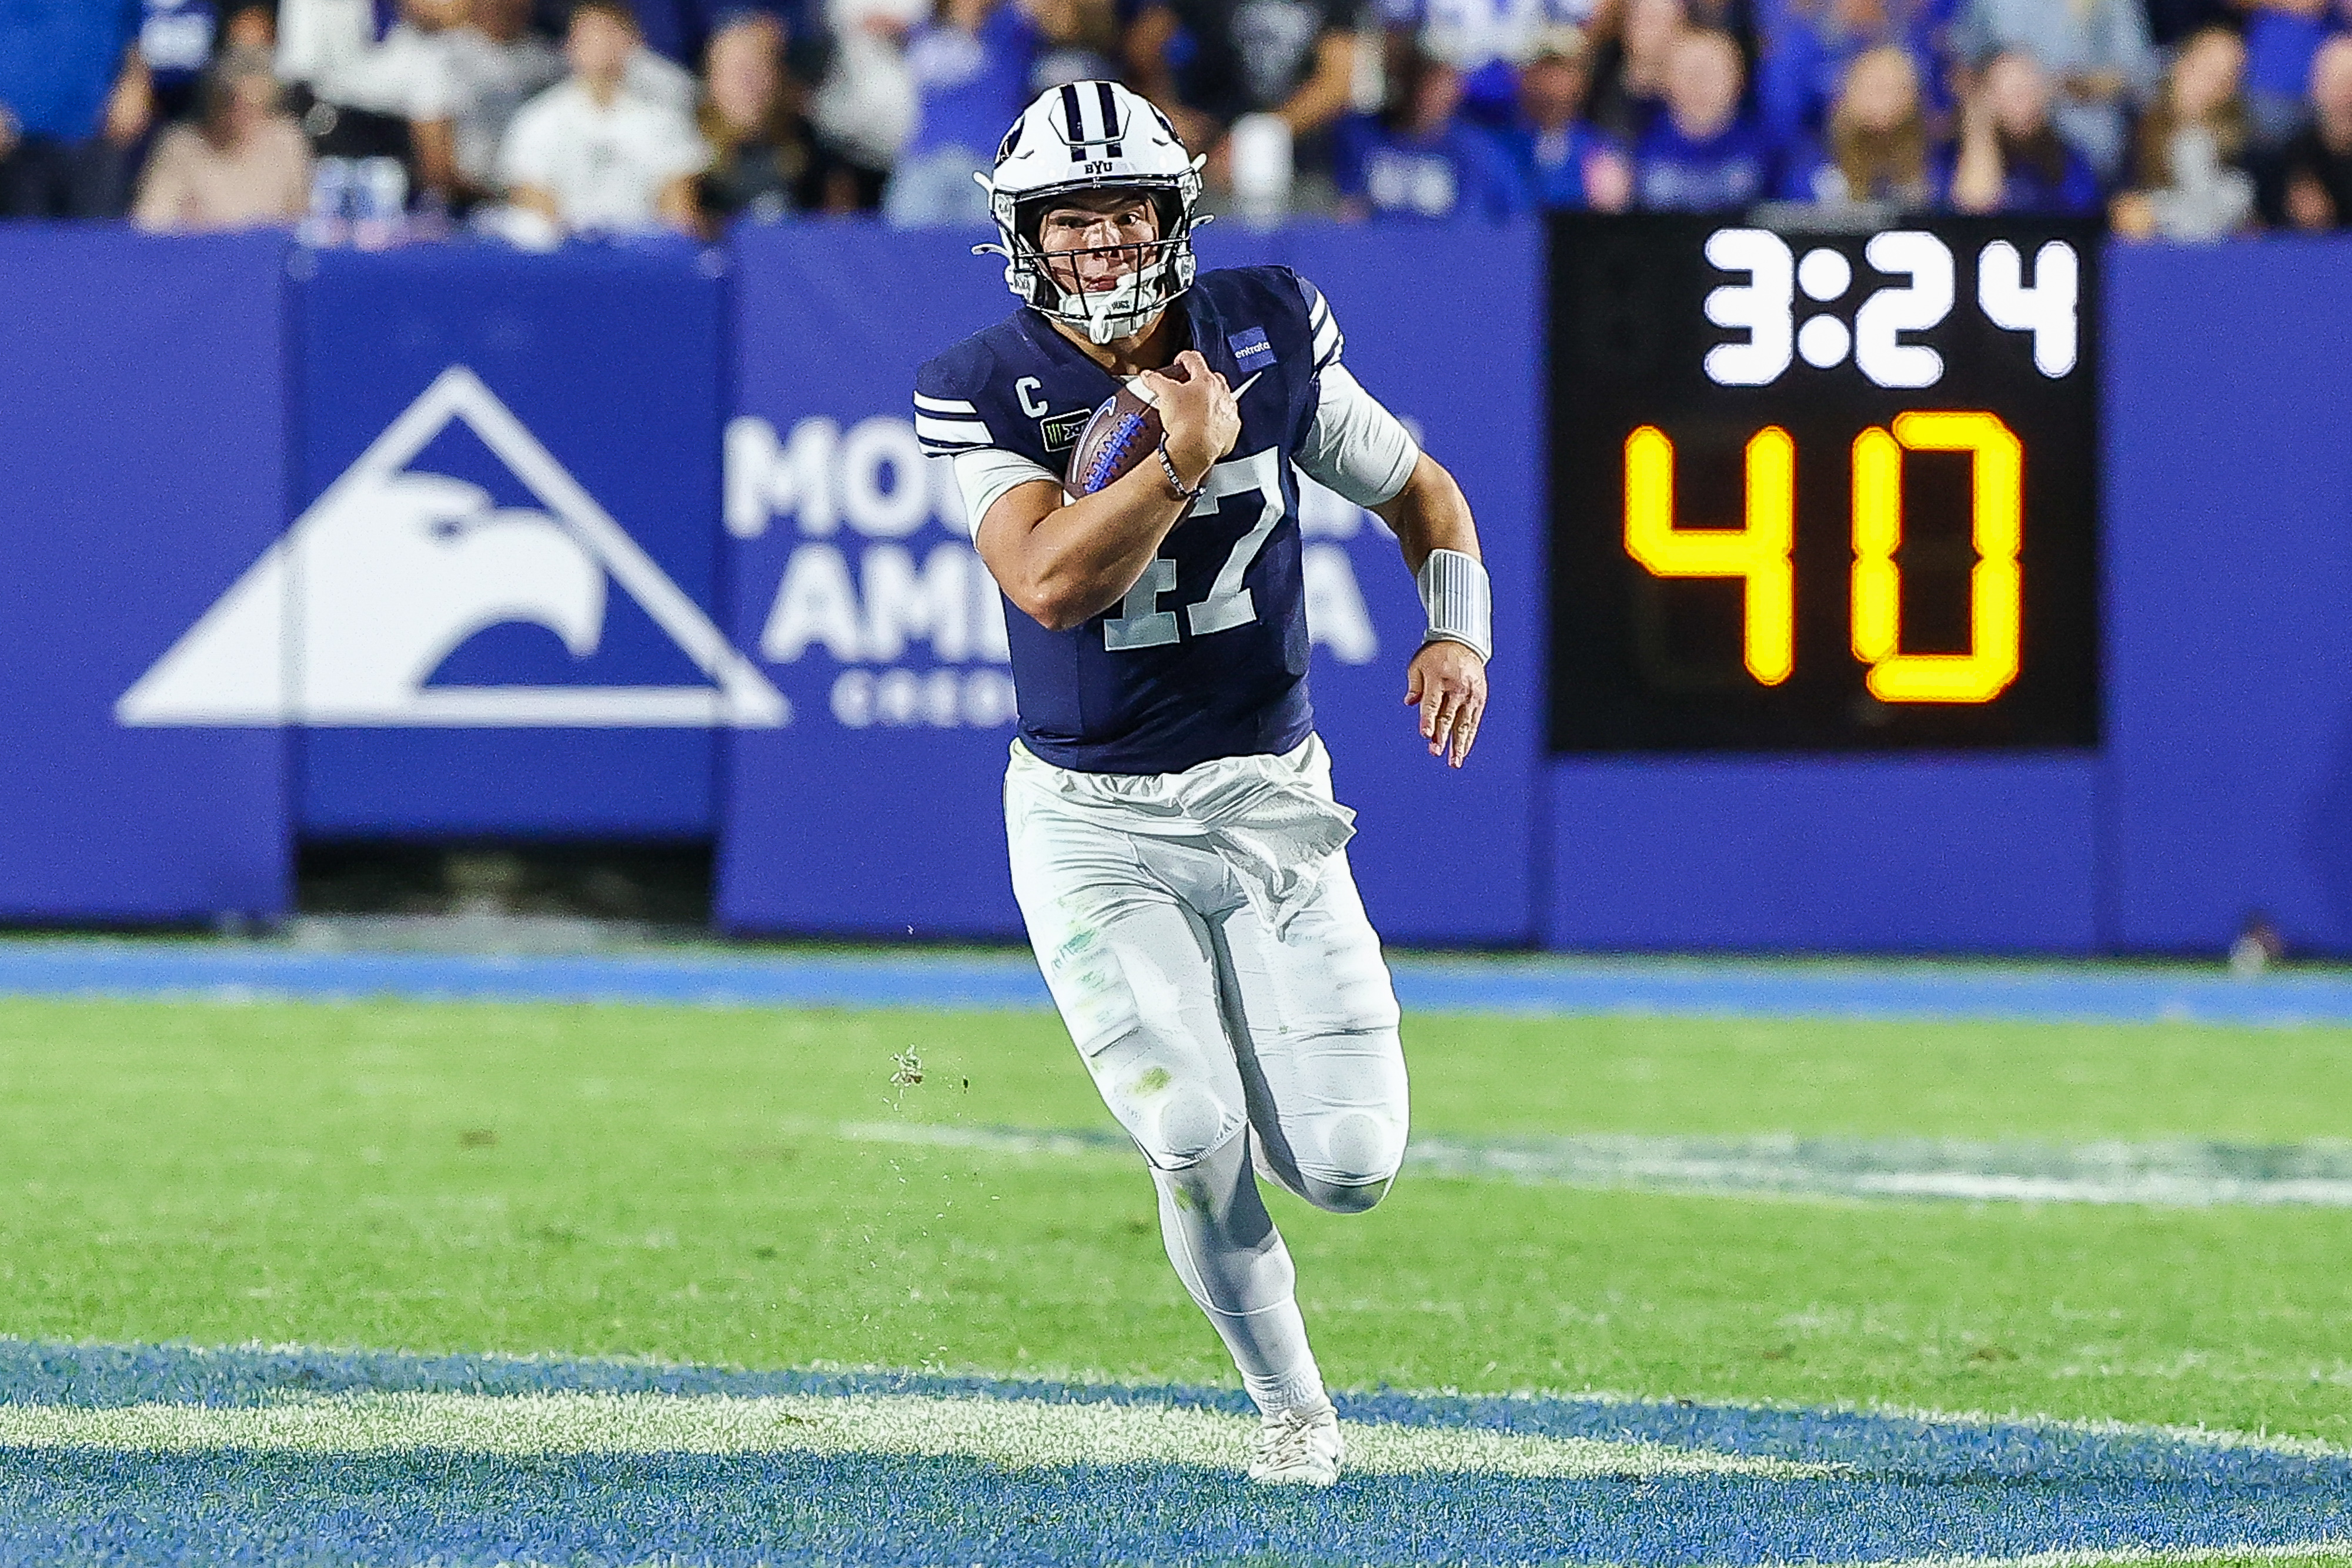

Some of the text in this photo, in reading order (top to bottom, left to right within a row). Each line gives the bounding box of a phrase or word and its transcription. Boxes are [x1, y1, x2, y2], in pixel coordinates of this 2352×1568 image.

[1084, 161, 1112, 175] BYU
[1704, 228, 2079, 388] 3:24
[1235, 342, 1271, 359] entrata
[1015, 376, 1048, 418] C
[1624, 409, 2024, 703] 40
